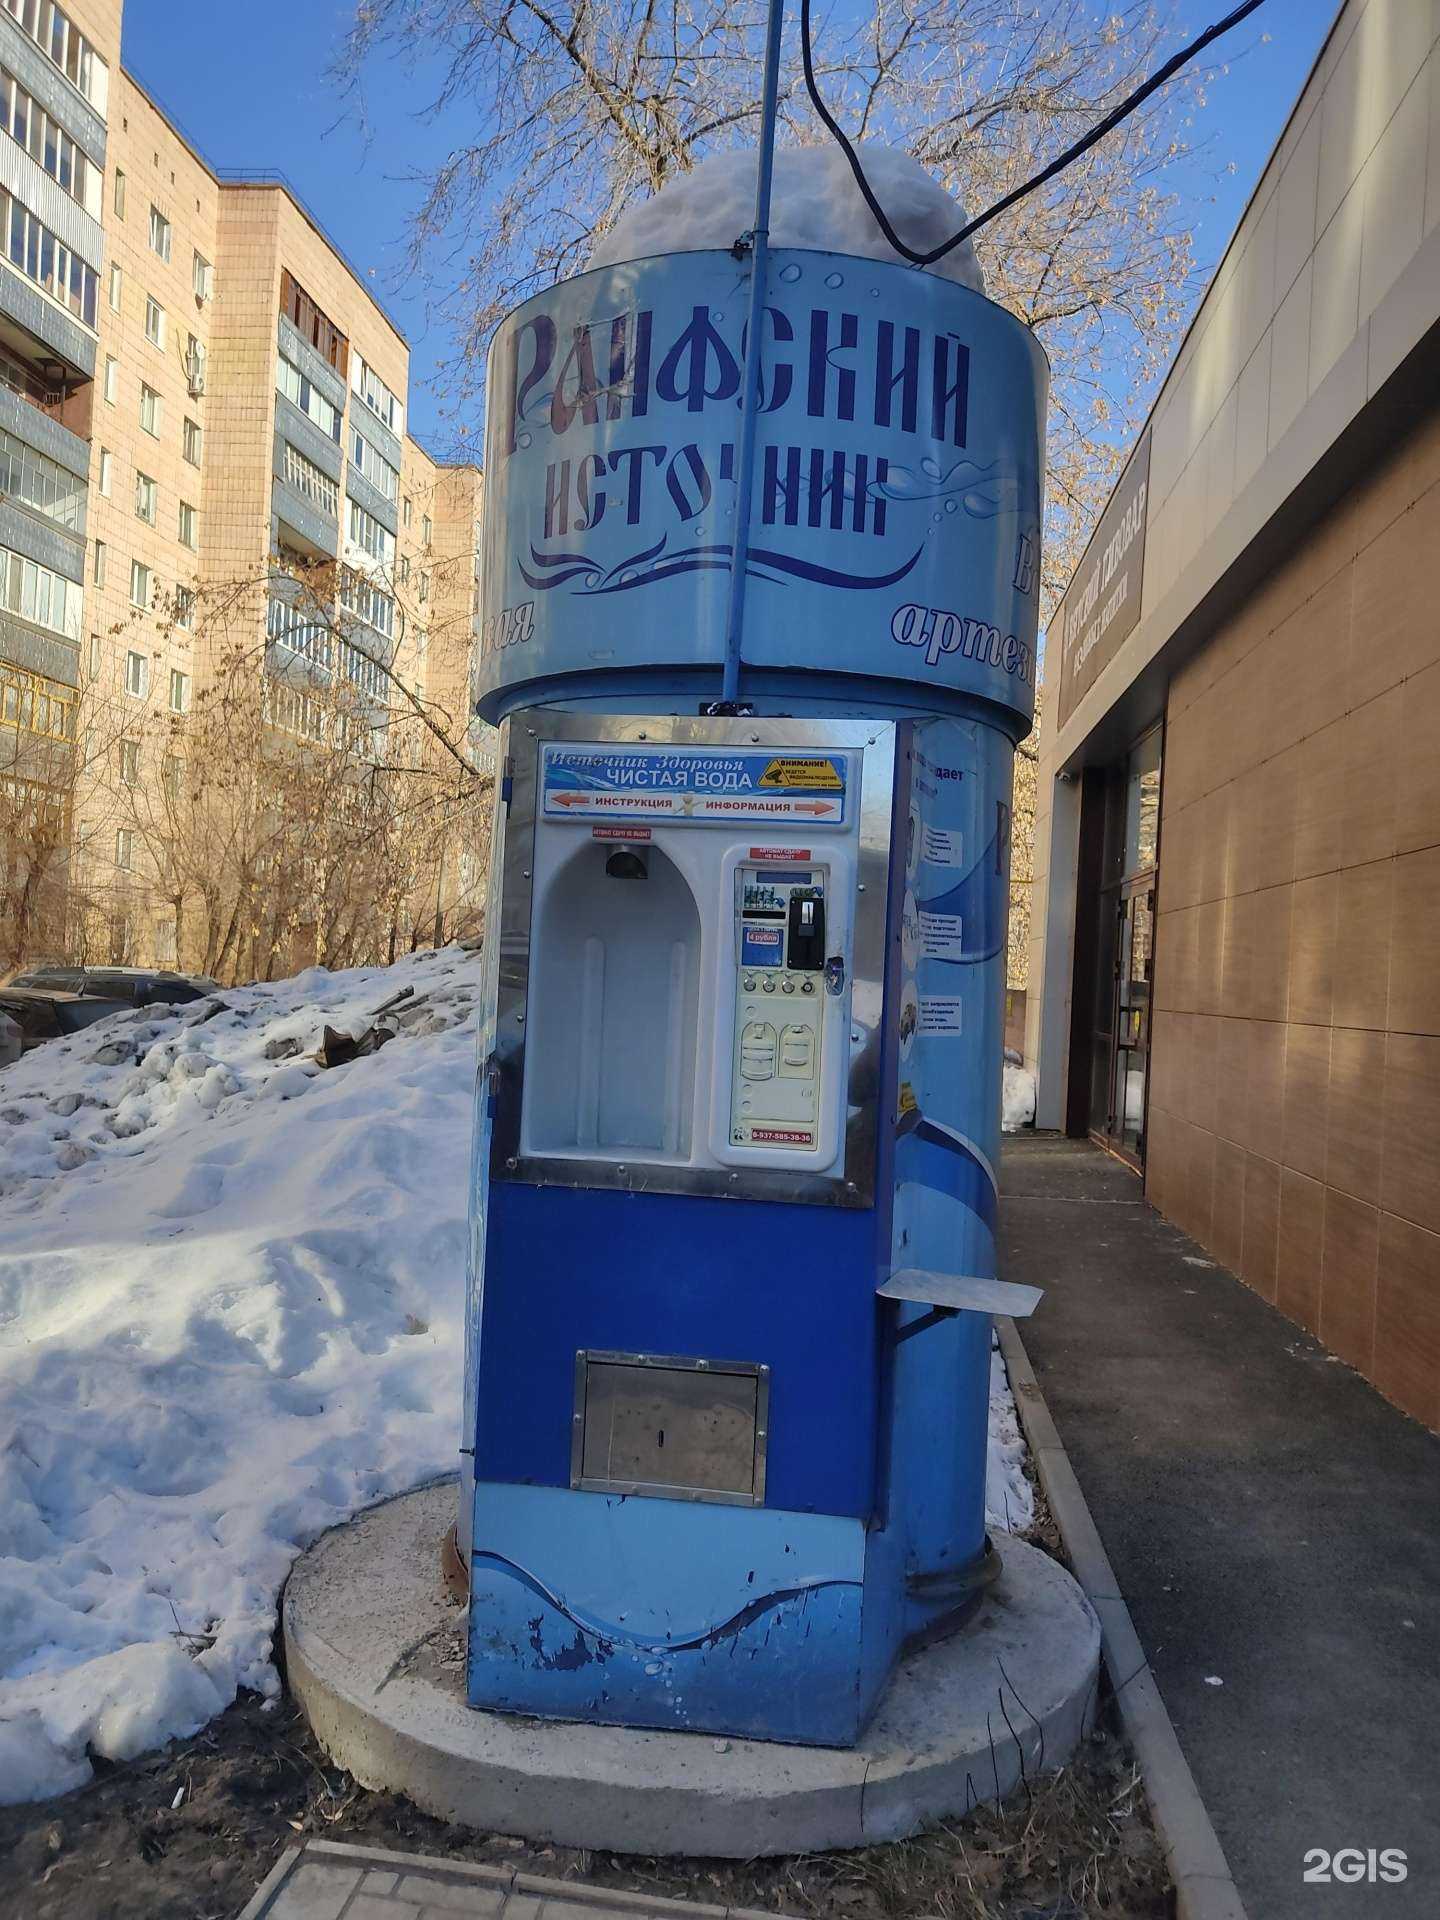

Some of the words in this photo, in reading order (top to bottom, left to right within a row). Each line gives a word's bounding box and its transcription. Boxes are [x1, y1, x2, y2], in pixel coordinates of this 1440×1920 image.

[551, 751, 648, 768] Источник
[656, 754, 743, 773] Здоровья
[606, 768, 688, 786] ЧИСТАЯ
[694, 770, 753, 790] ВОДА
[595, 797, 673, 809] ИНСТРУКЦИЯ
[705, 801, 791, 812] ИНФОРМАЦИЯ
